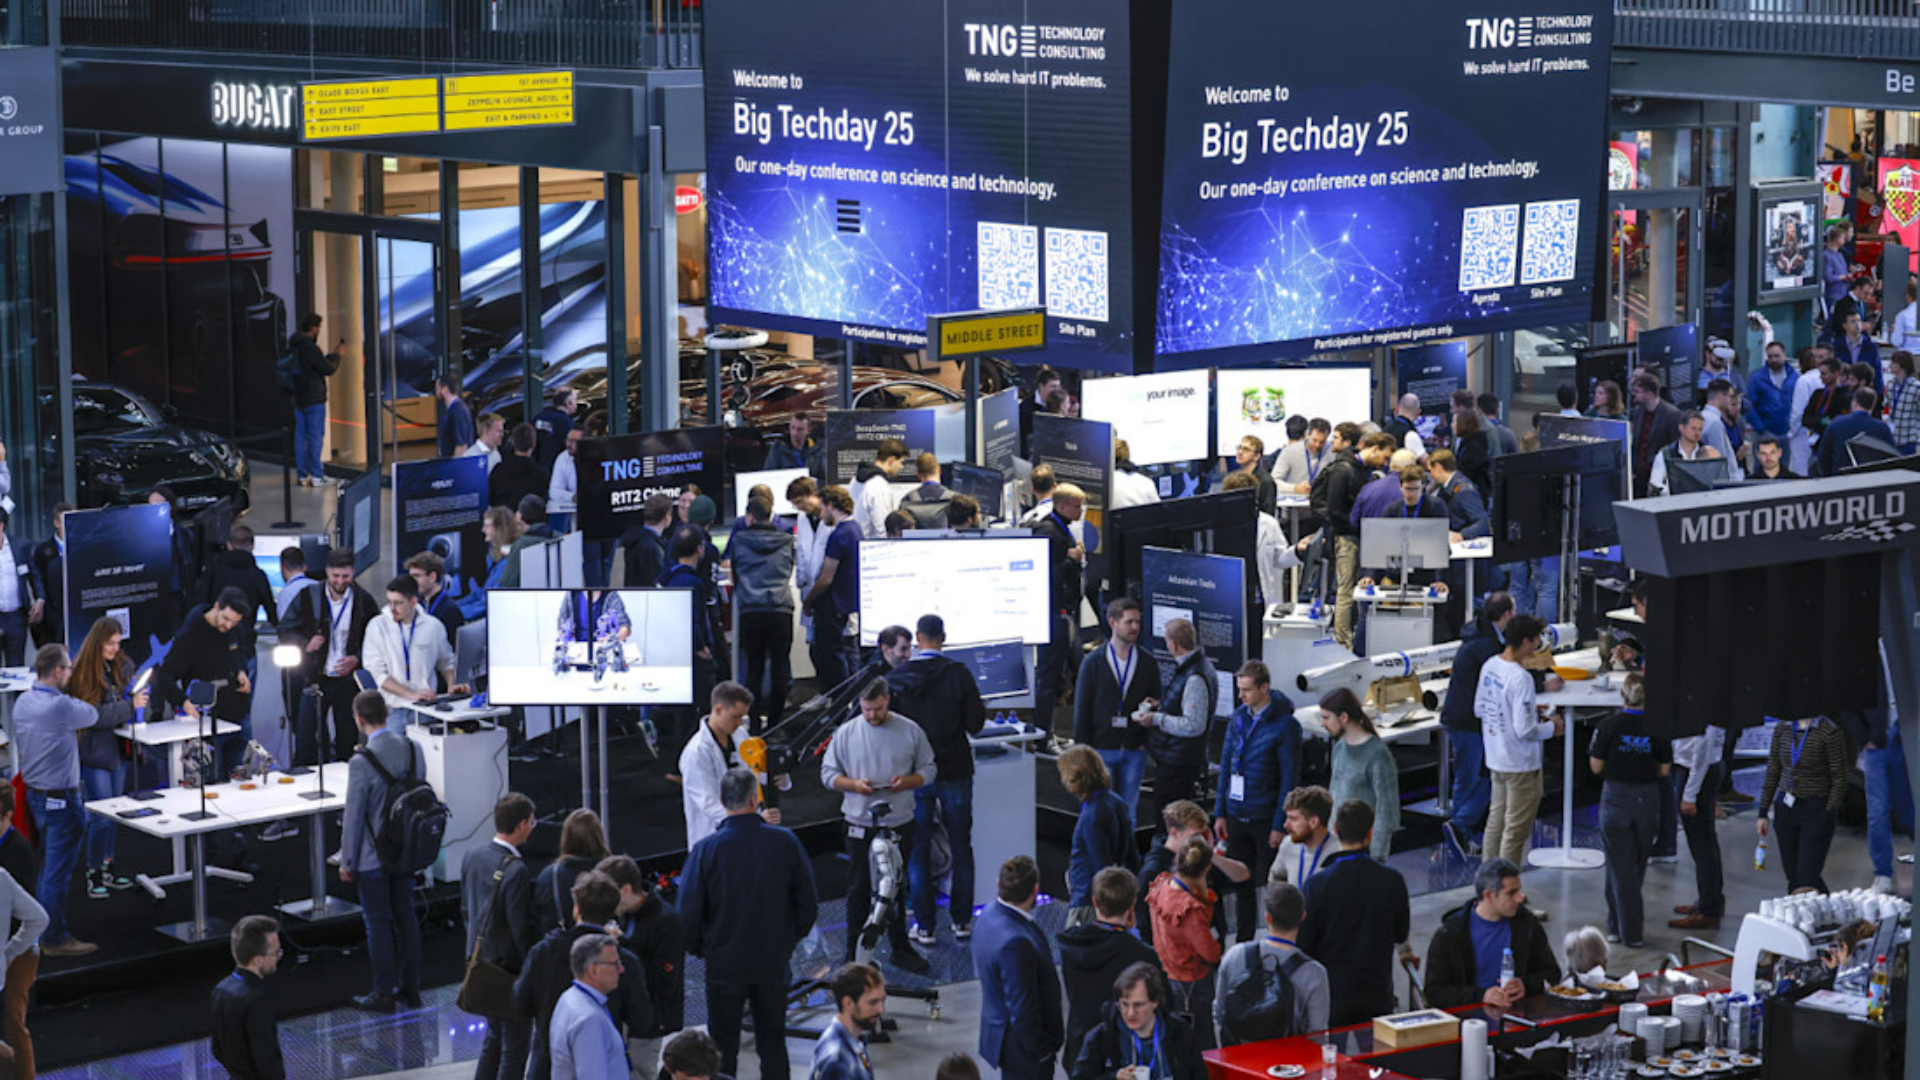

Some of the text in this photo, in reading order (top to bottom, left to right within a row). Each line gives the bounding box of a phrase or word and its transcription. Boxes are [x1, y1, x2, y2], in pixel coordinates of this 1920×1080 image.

[1535, 15, 1593, 29] TECHNOLOGY
[964, 23, 1017, 57] TNG
[1038, 26, 1105, 41] TECHNOLOGY
[1466, 18, 1515, 49] TNG
[1534, 32, 1592, 46] CONSULTING
[1038, 44, 1105, 60] CONSULTING
[1463, 57, 1590, 75] We solve hard IT problems.
[733, 70, 803, 89] Welcome to
[964, 68, 1106, 89] We solve hard IT problems.
[1886, 69, 1915, 93] Be
[211, 82, 297, 128] BUGAT
[1205, 85, 1289, 105] Welcome to
[8, 124, 44, 136] GROUP
[734, 102, 914, 151] Big Techday 25
[1202, 111, 1409, 165] Big Techday 25
[735, 155, 1057, 201] Our one-day conference on science and technology.
[1200, 158, 1539, 199] Our one-day conference on science and technology.
[1472, 291, 1500, 306] Agenda
[1530, 286, 1563, 299] Site Plan
[842, 324, 885, 340] Participation
[886, 329, 897, 341] for
[946, 323, 1040, 345] MIDDLE STREET
[1059, 322, 1096, 337] Site Plan
[1314, 335, 1361, 350] Participation
[1362, 333, 1373, 344] for
[1374, 329, 1412, 344] registered
[1412, 327, 1436, 341] guests
[1146, 389, 1166, 402] your
[1168, 386, 1197, 399] image.
[656, 450, 703, 463] TECHNOLOGY
[600, 457, 641, 481] TNG
[656, 462, 703, 476] CONSULTING
[611, 485, 682, 505] R1T2 Chime
[1681, 490, 1905, 544] MOTORWORLD
